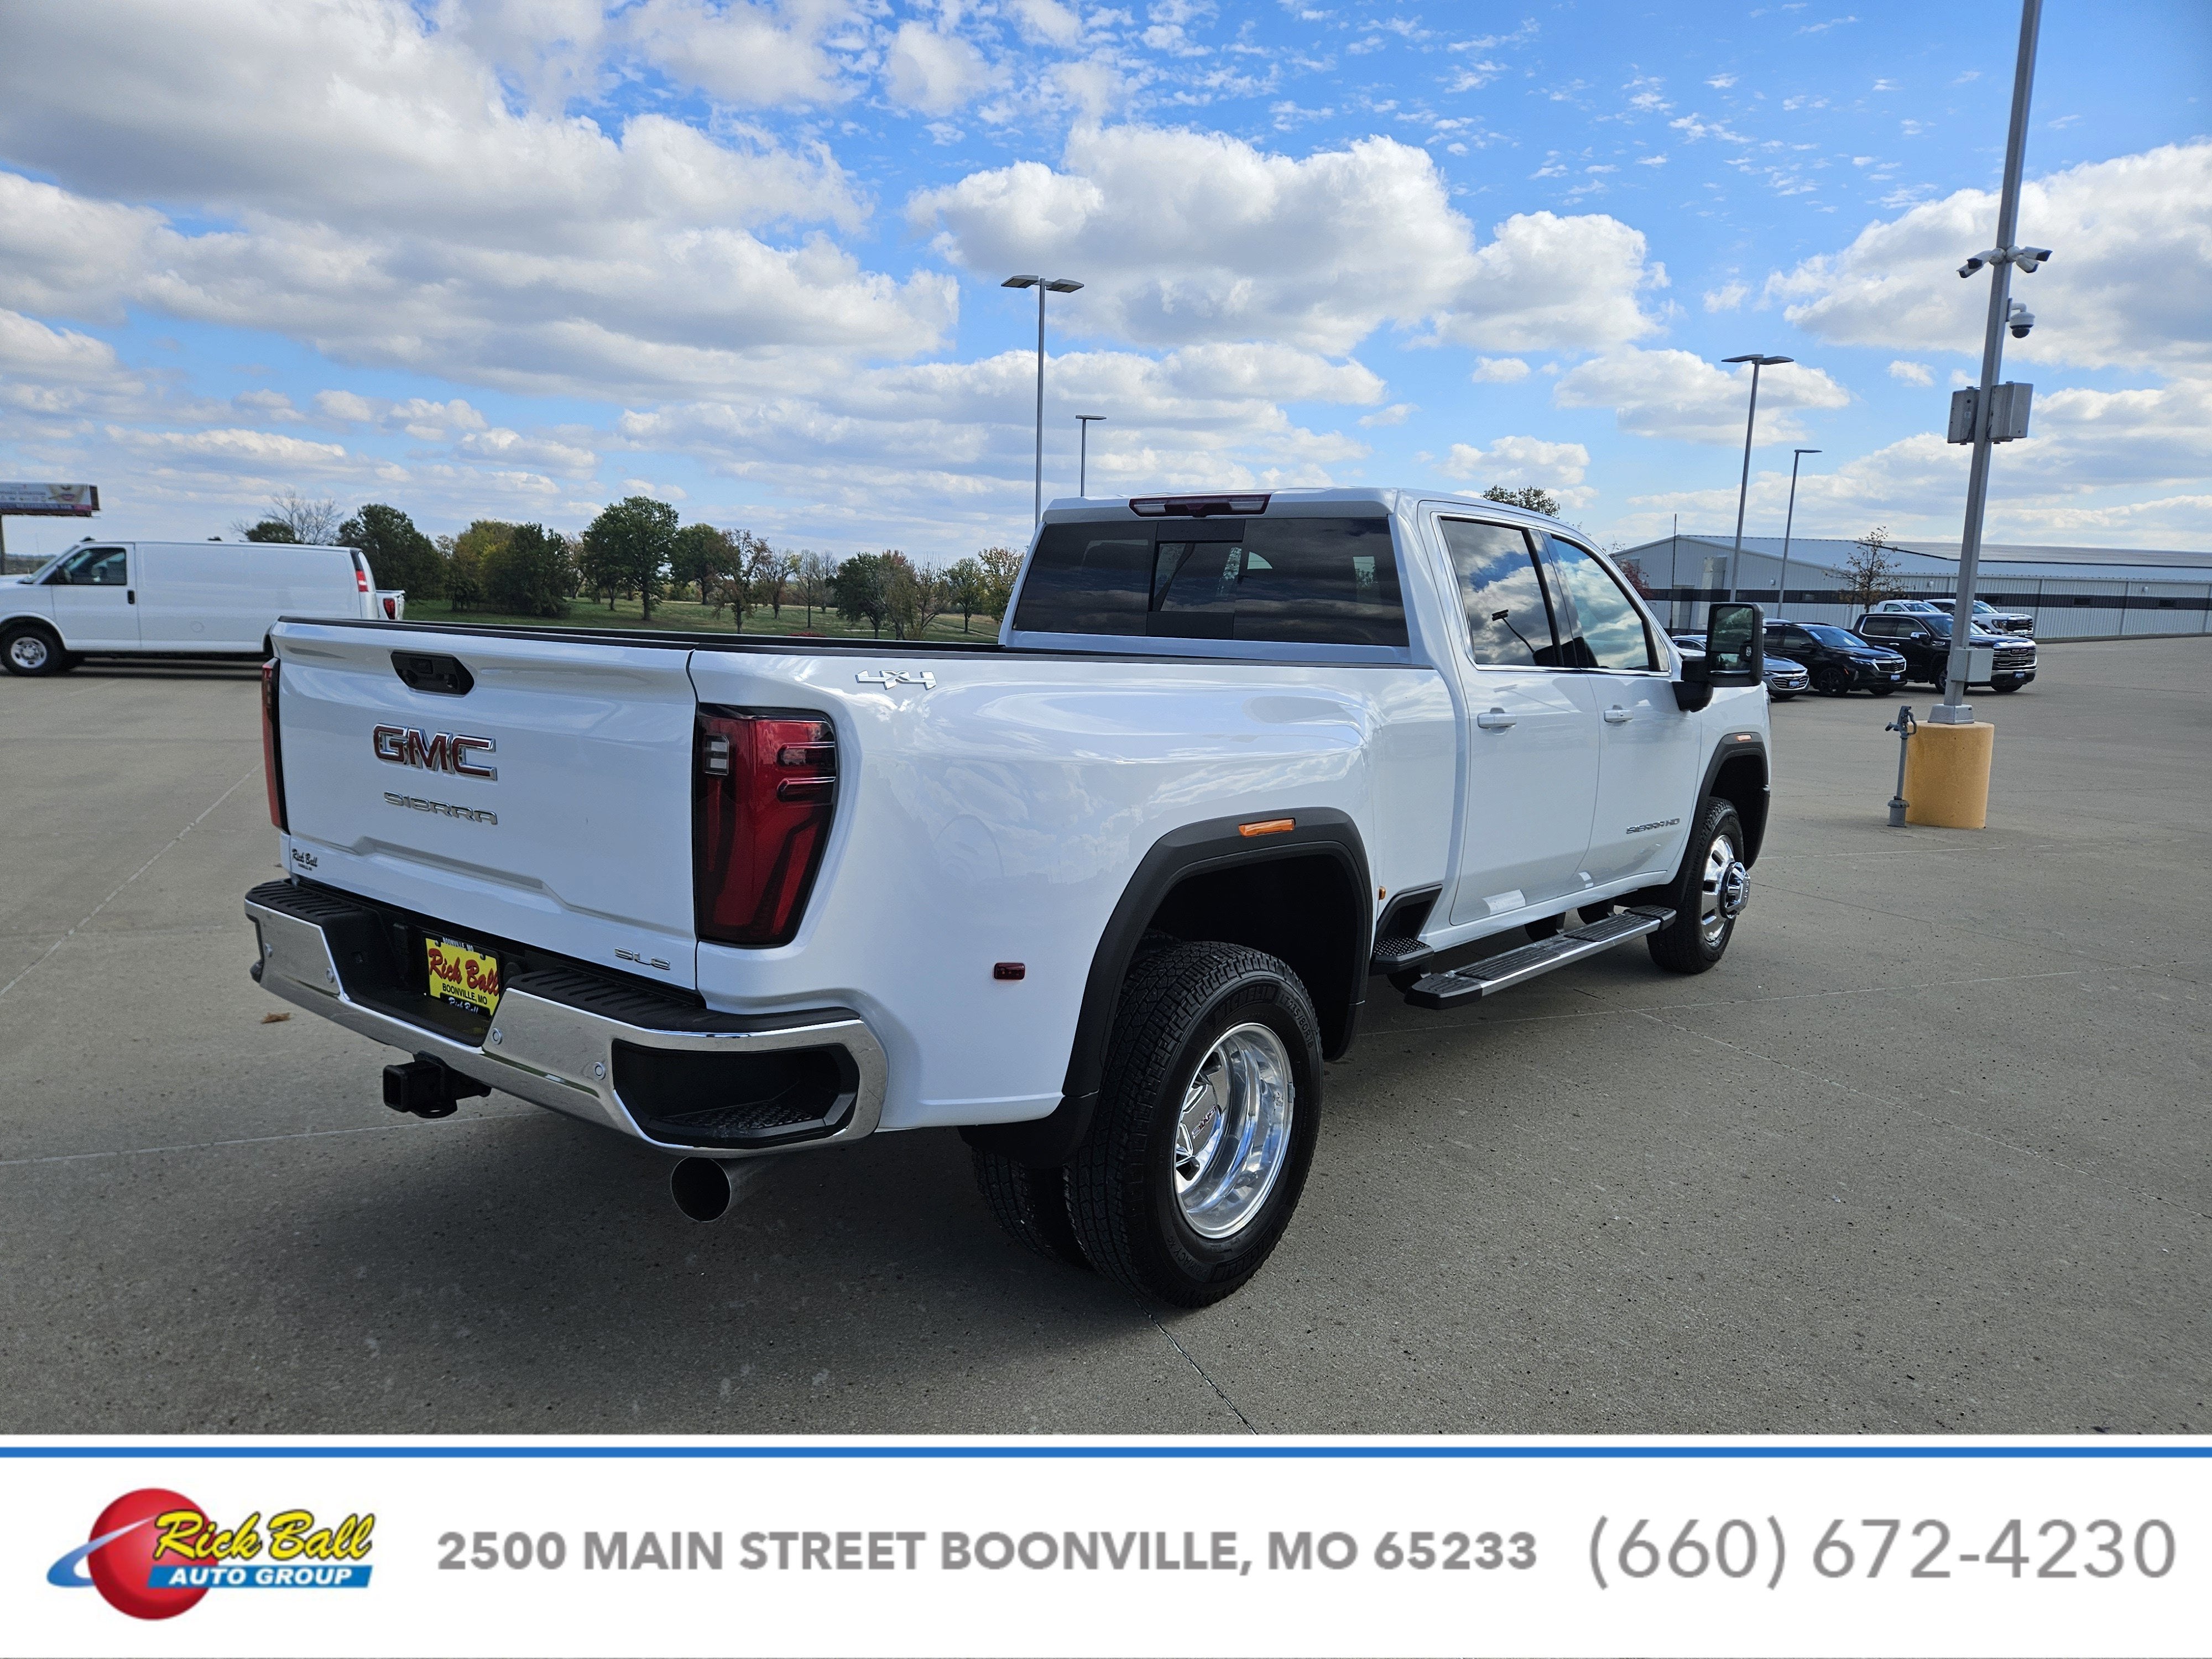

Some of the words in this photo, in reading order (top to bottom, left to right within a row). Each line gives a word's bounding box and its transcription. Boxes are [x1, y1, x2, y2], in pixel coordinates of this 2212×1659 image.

[373, 722, 498, 781] GMC
[384, 791, 498, 826] SIERRA
[1626, 821, 1665, 834] SIERRA
[1665, 818, 1680, 827] HD
[429, 948, 462, 984] Rick
[465, 959, 499, 997] Ball
[614, 947, 671, 971] SLE
[442, 983, 477, 1003] BOONVILLE,
[478, 994, 488, 1005] MO
[1191, 1104, 1216, 1140] GMC
